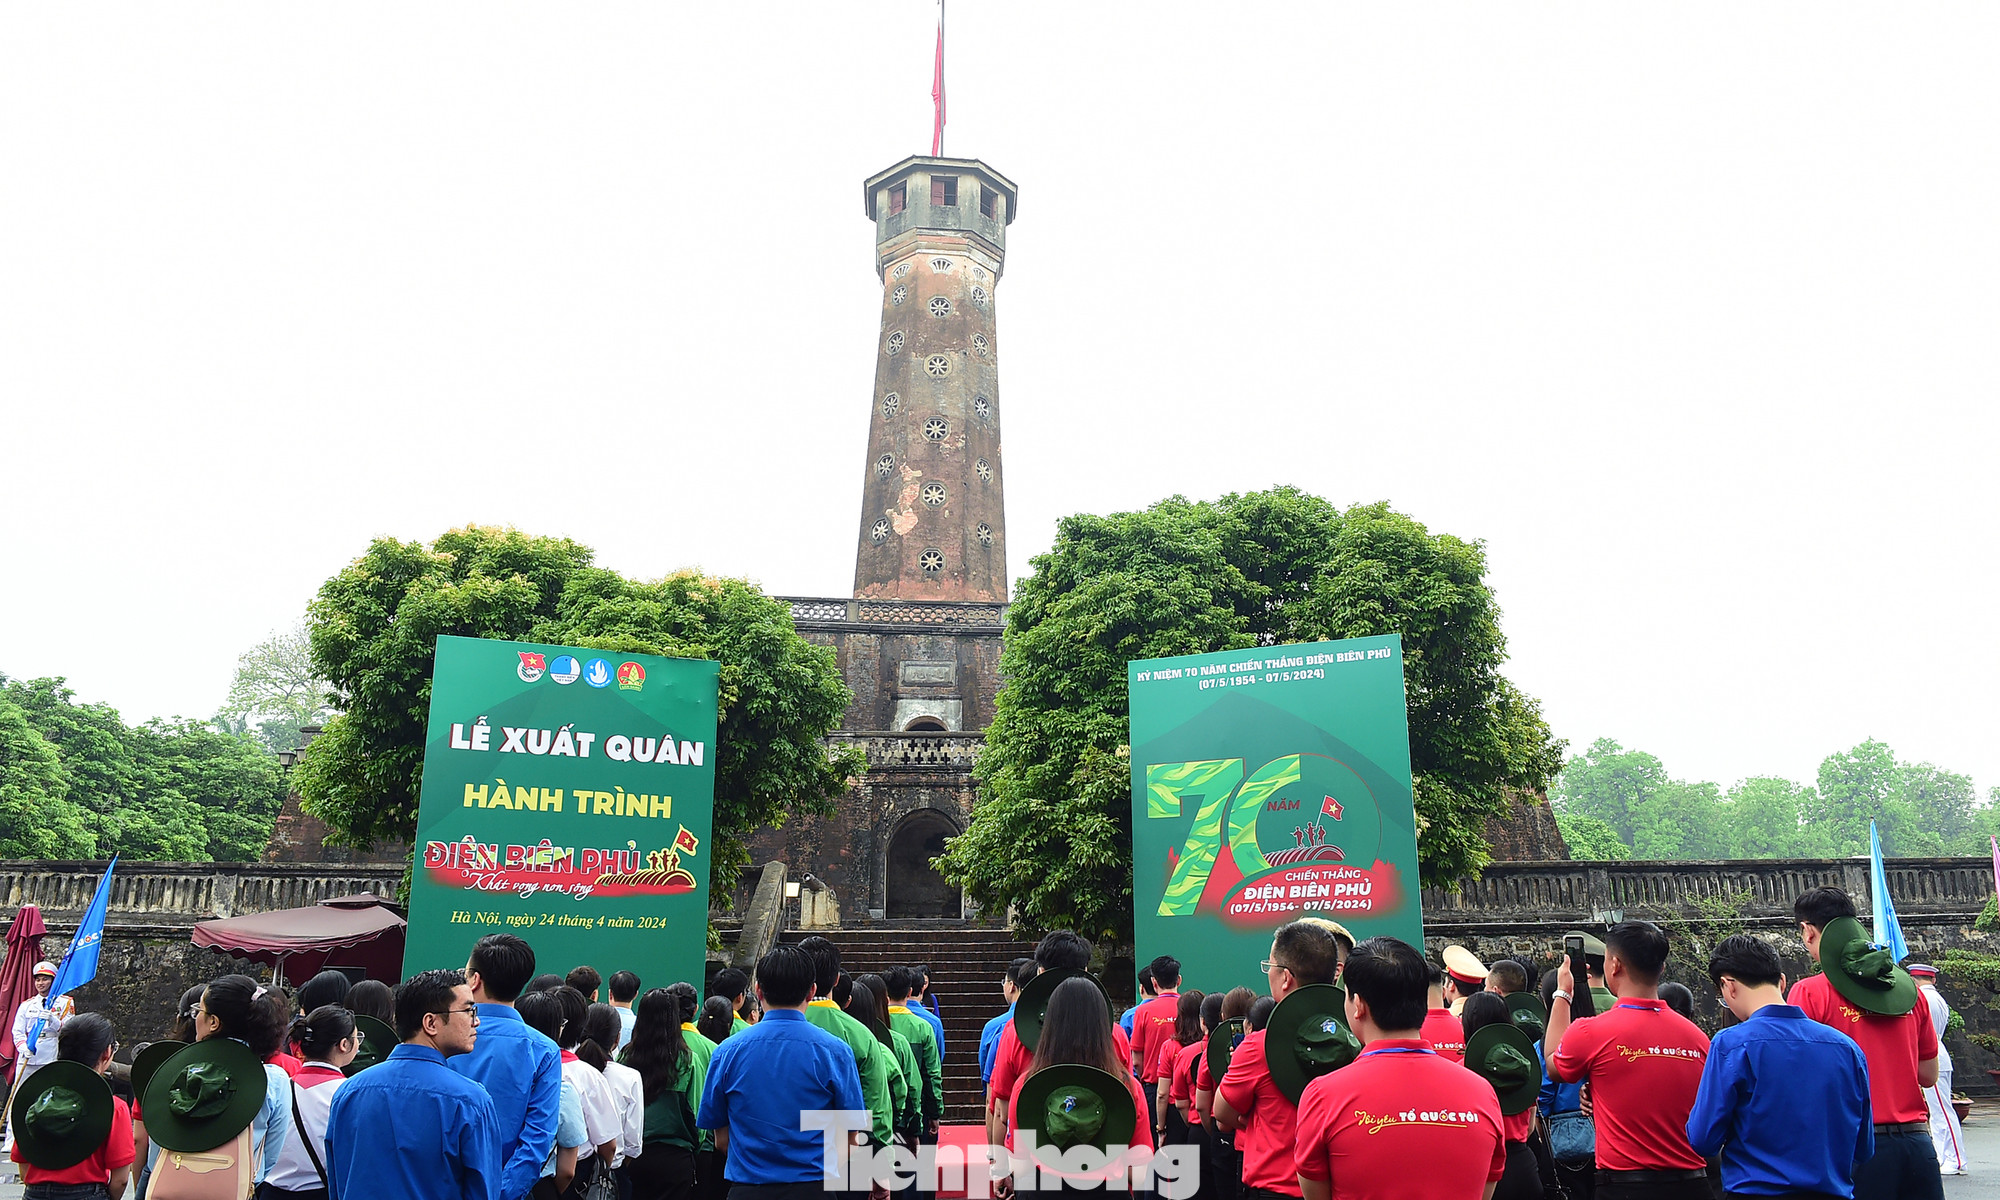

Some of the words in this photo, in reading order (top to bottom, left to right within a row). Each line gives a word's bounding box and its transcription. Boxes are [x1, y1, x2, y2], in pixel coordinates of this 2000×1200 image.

[1153, 668, 1182, 681] NIỆM
[1185, 667, 1198, 677] 70
[1200, 664, 1227, 676] NĂM
[1229, 658, 1262, 673] CHIẾN
[1265, 655, 1303, 669] THẮNG
[1306, 653, 1334, 666] ĐIỆN
[1336, 650, 1364, 662] BIÊN
[1367, 646, 1391, 660] PHỦ
[1199, 675, 1256, 690] (07/5/1954
[1265, 669, 1325, 683] 07/5/2024)
[450, 716, 491, 751] LỄ
[498, 723, 595, 758] XUẤT
[605, 734, 704, 766] QUÂN
[463, 778, 564, 812] HÀNH
[573, 785, 672, 819] TRÌNH
[1266, 798, 1300, 811] NĂM
[505, 839, 575, 873] BIÊN
[581, 840, 640, 876] PHỦ
[1285, 869, 1319, 881] CHIẾN
[1322, 867, 1361, 880] THẮNG
[465, 871, 510, 891] Khát
[512, 882, 540, 899] vọng
[542, 884, 564, 893] non
[564, 882, 594, 900] sông
[1289, 882, 1330, 898] BIÊN
[1334, 878, 1372, 897] PHỦ
[1303, 899, 1372, 911] 07/5/2024)
[450, 911, 471, 924] Hà
[474, 911, 502, 926] Nội,
[506, 912, 536, 928] ngày
[539, 913, 555, 926] 24
[557, 914, 593, 929] tháng
[596, 915, 605, 927] 4
[607, 915, 634, 928] năm
[637, 916, 667, 929] 2024
[1662, 1047, 1687, 1056] QUỐC
[1399, 1108, 1416, 1122] TỔ
[1420, 1109, 1457, 1122] QUỐC
[1458, 1111, 1479, 1123] TÔI
